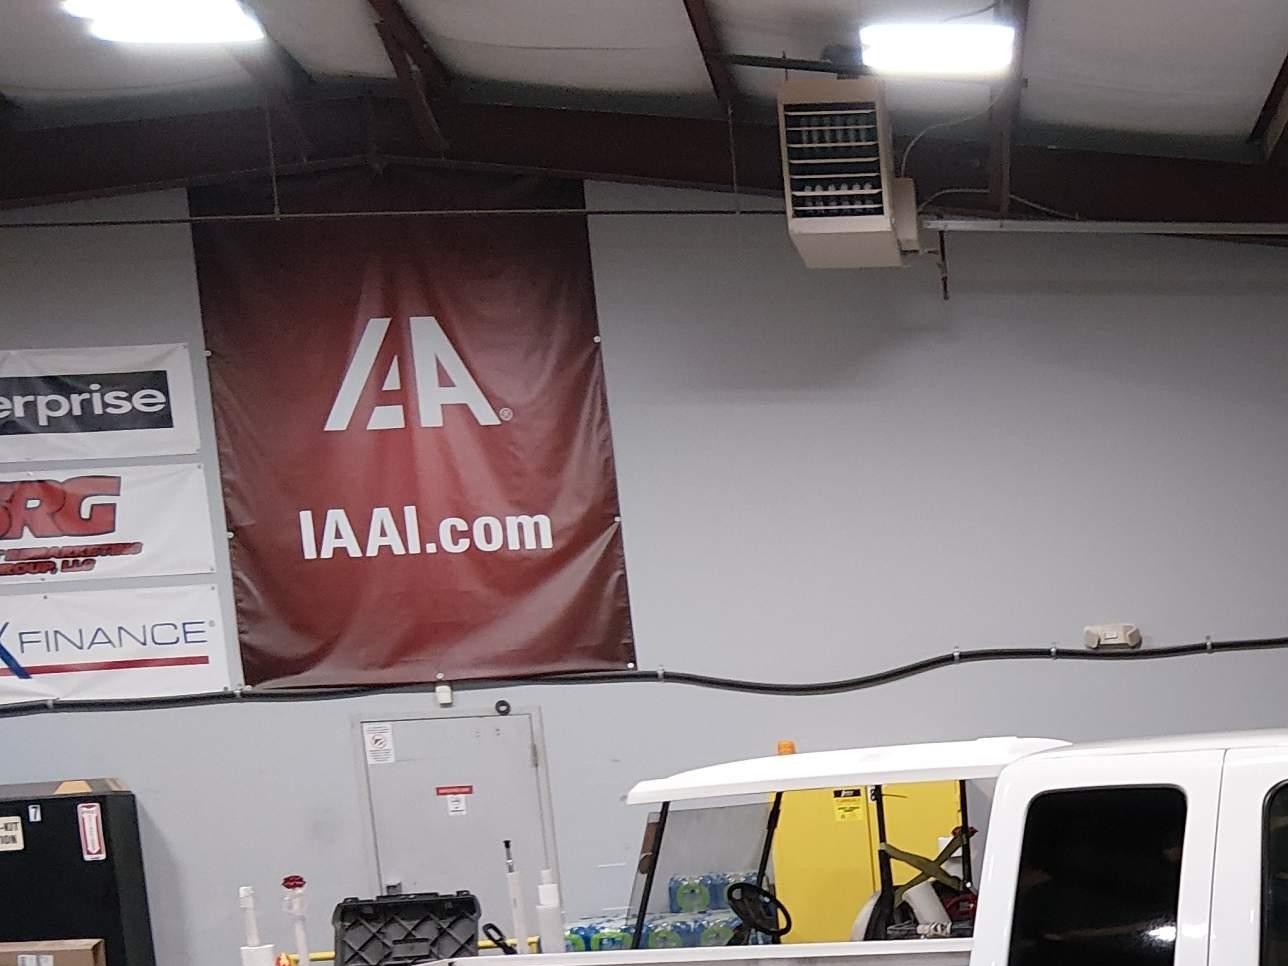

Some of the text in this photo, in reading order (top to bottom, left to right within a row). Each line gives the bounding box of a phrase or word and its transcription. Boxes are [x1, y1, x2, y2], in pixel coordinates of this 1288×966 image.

[0, 475, 122, 540] RG
[300, 506, 553, 560] IAAI.com
[31, 806, 39, 820] 7
